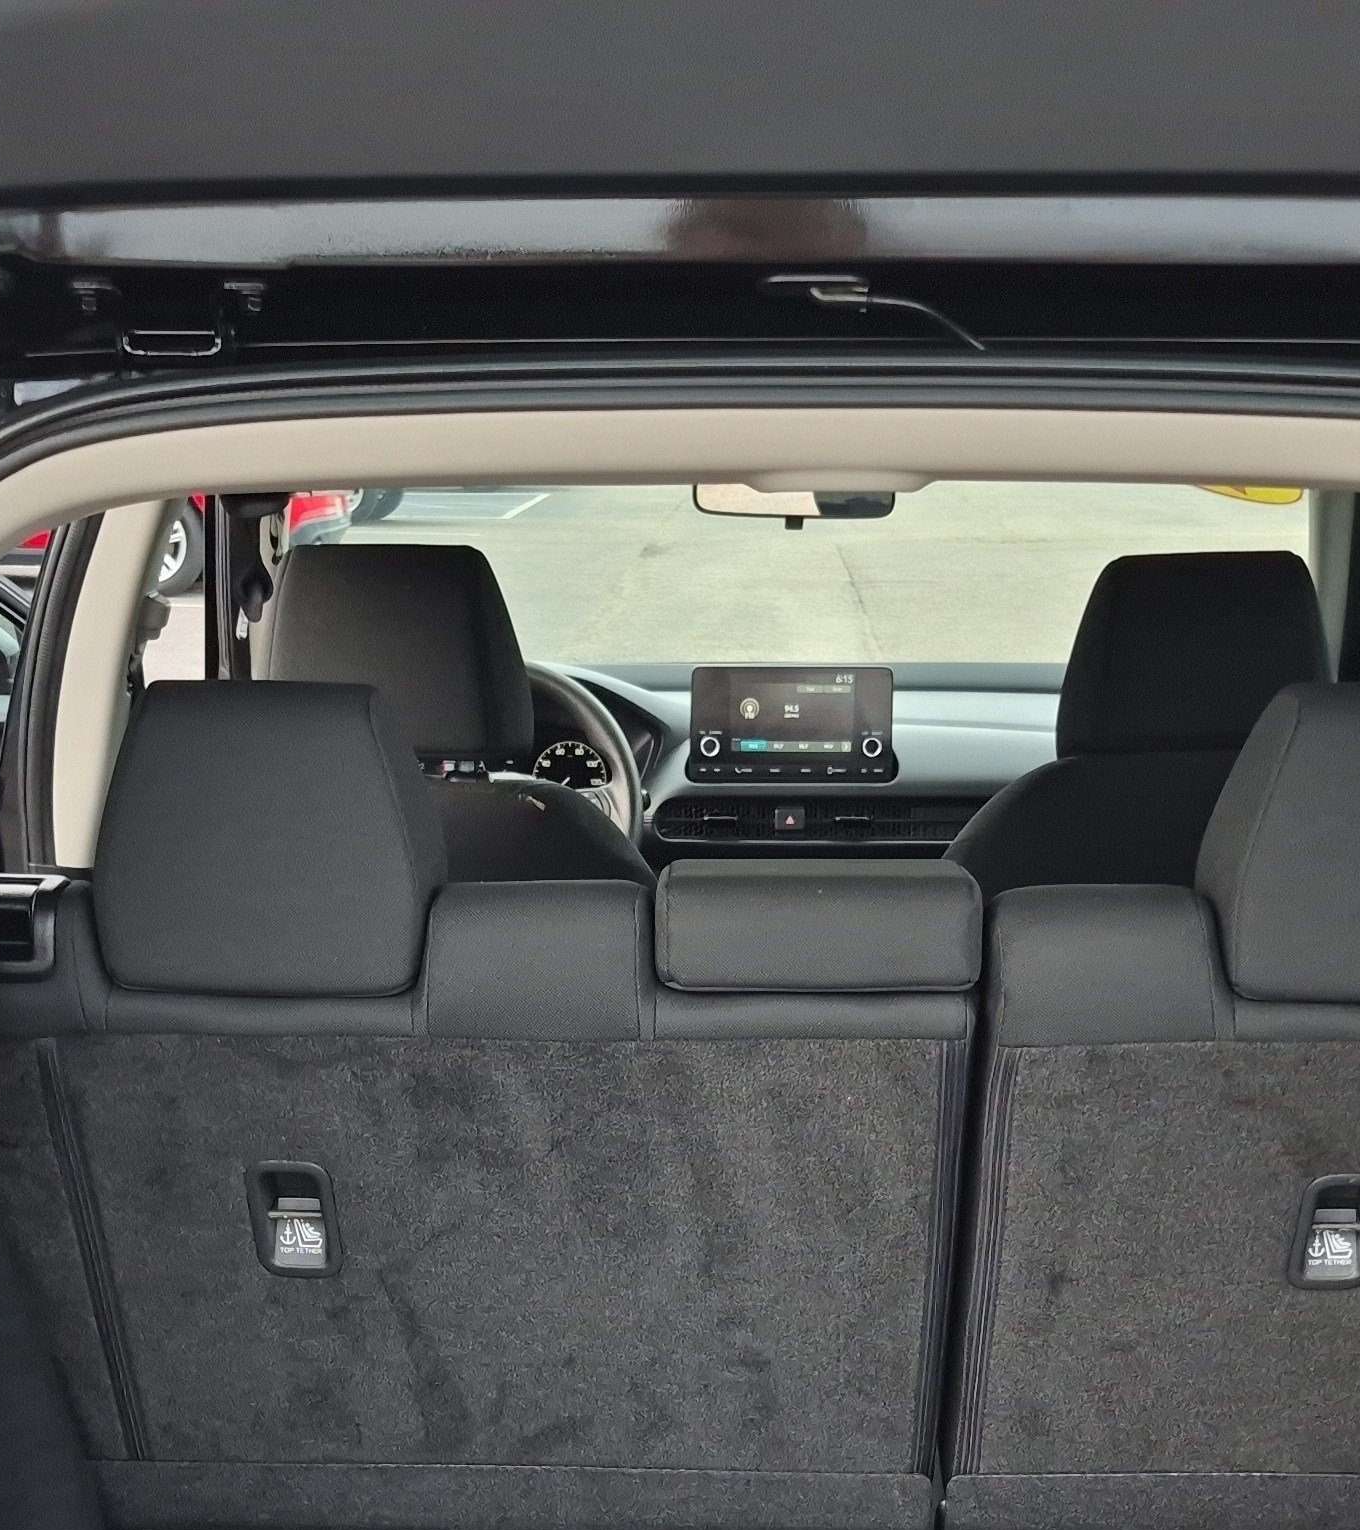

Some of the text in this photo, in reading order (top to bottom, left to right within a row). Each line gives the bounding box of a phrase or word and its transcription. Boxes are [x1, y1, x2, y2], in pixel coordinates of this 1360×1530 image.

[835, 674, 854, 684] 6:15
[280, 1246, 323, 1255] TOP TETHER
